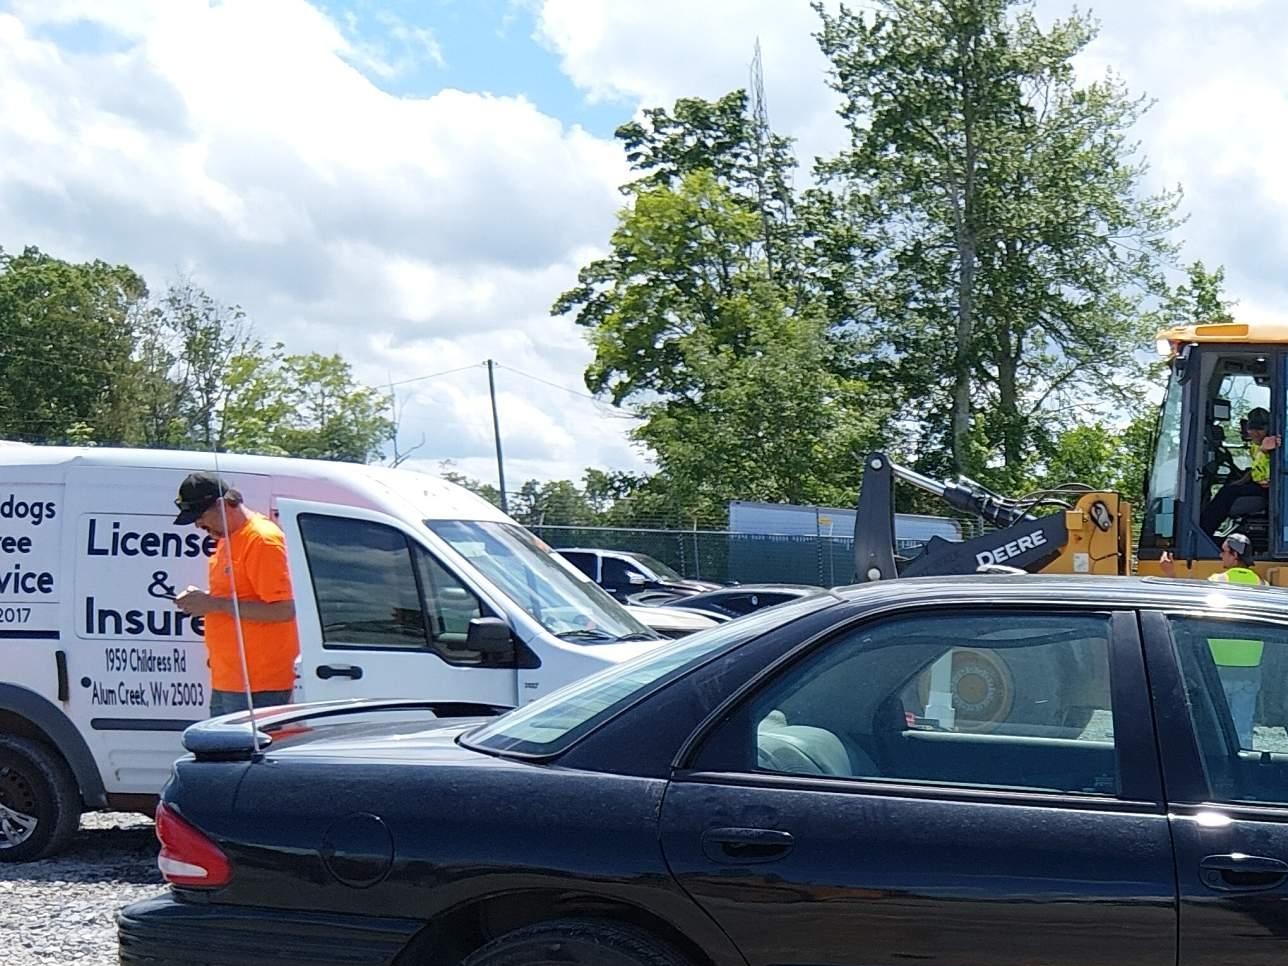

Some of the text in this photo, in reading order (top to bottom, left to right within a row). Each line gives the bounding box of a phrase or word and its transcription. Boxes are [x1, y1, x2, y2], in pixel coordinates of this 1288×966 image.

[0, 494, 56, 526] dogs
[0, 536, 32, 554] ee
[87, 519, 217, 558] License
[976, 530, 1047, 566] DEERE
[148, 571, 177, 599] &
[105, 648, 186, 672] 1959 Childress Rd
[92, 681, 204, 706] Alum Creek, Wv 25003
